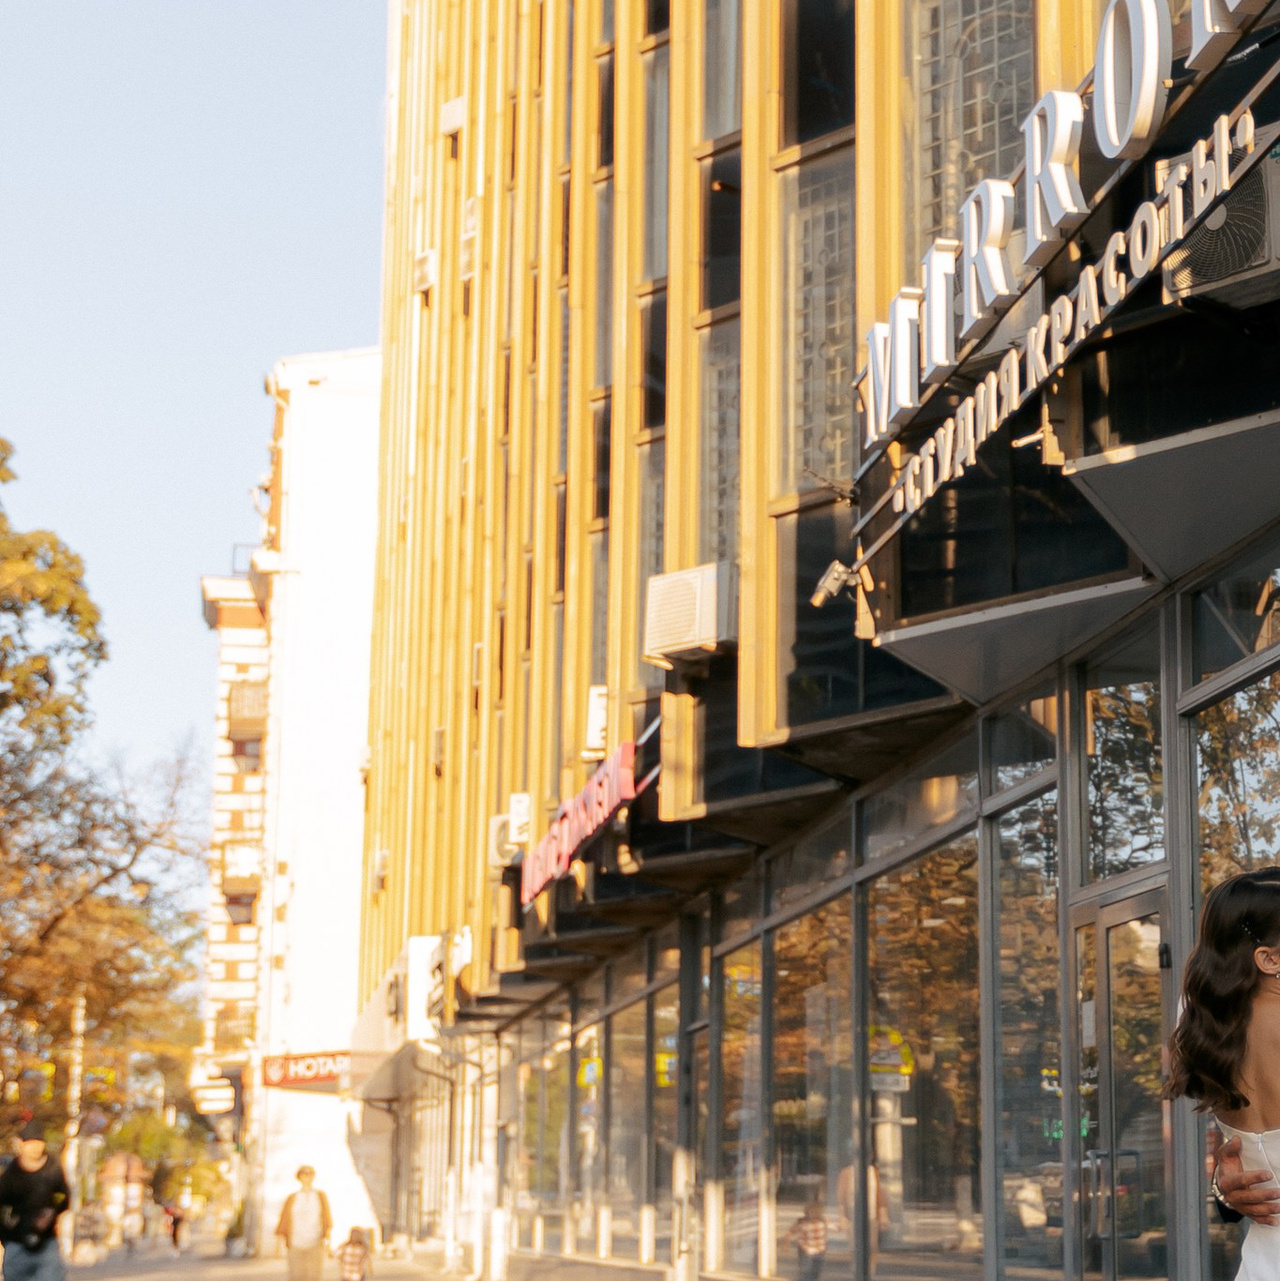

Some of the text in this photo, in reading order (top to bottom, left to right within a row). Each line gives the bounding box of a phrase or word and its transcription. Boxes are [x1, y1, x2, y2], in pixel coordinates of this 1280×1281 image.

[904, 113, 1231, 514] СТУДИЯ КРАСОТЫ
[288, 1055, 350, 1078] НОТАР
